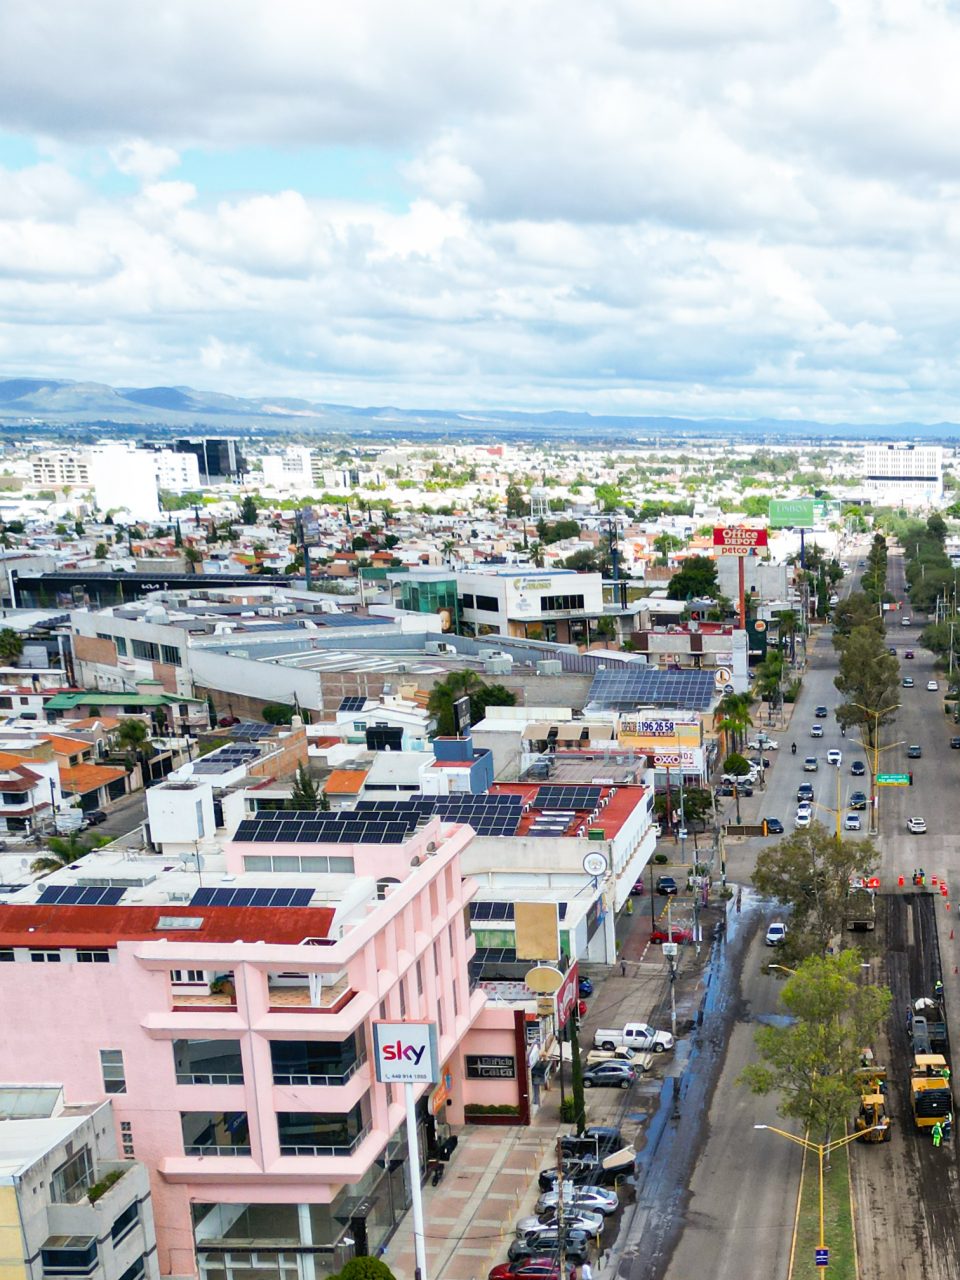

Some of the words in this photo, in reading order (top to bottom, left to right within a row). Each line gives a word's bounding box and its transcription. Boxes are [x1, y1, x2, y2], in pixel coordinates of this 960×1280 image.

[722, 529, 758, 539] Office
[724, 538, 756, 546] DEPOT
[721, 546, 748, 555] petco
[654, 721, 664, 732] 26
[664, 721, 674, 732] 58
[653, 755, 680, 764] OXXO
[382, 1040, 426, 1066] sky
